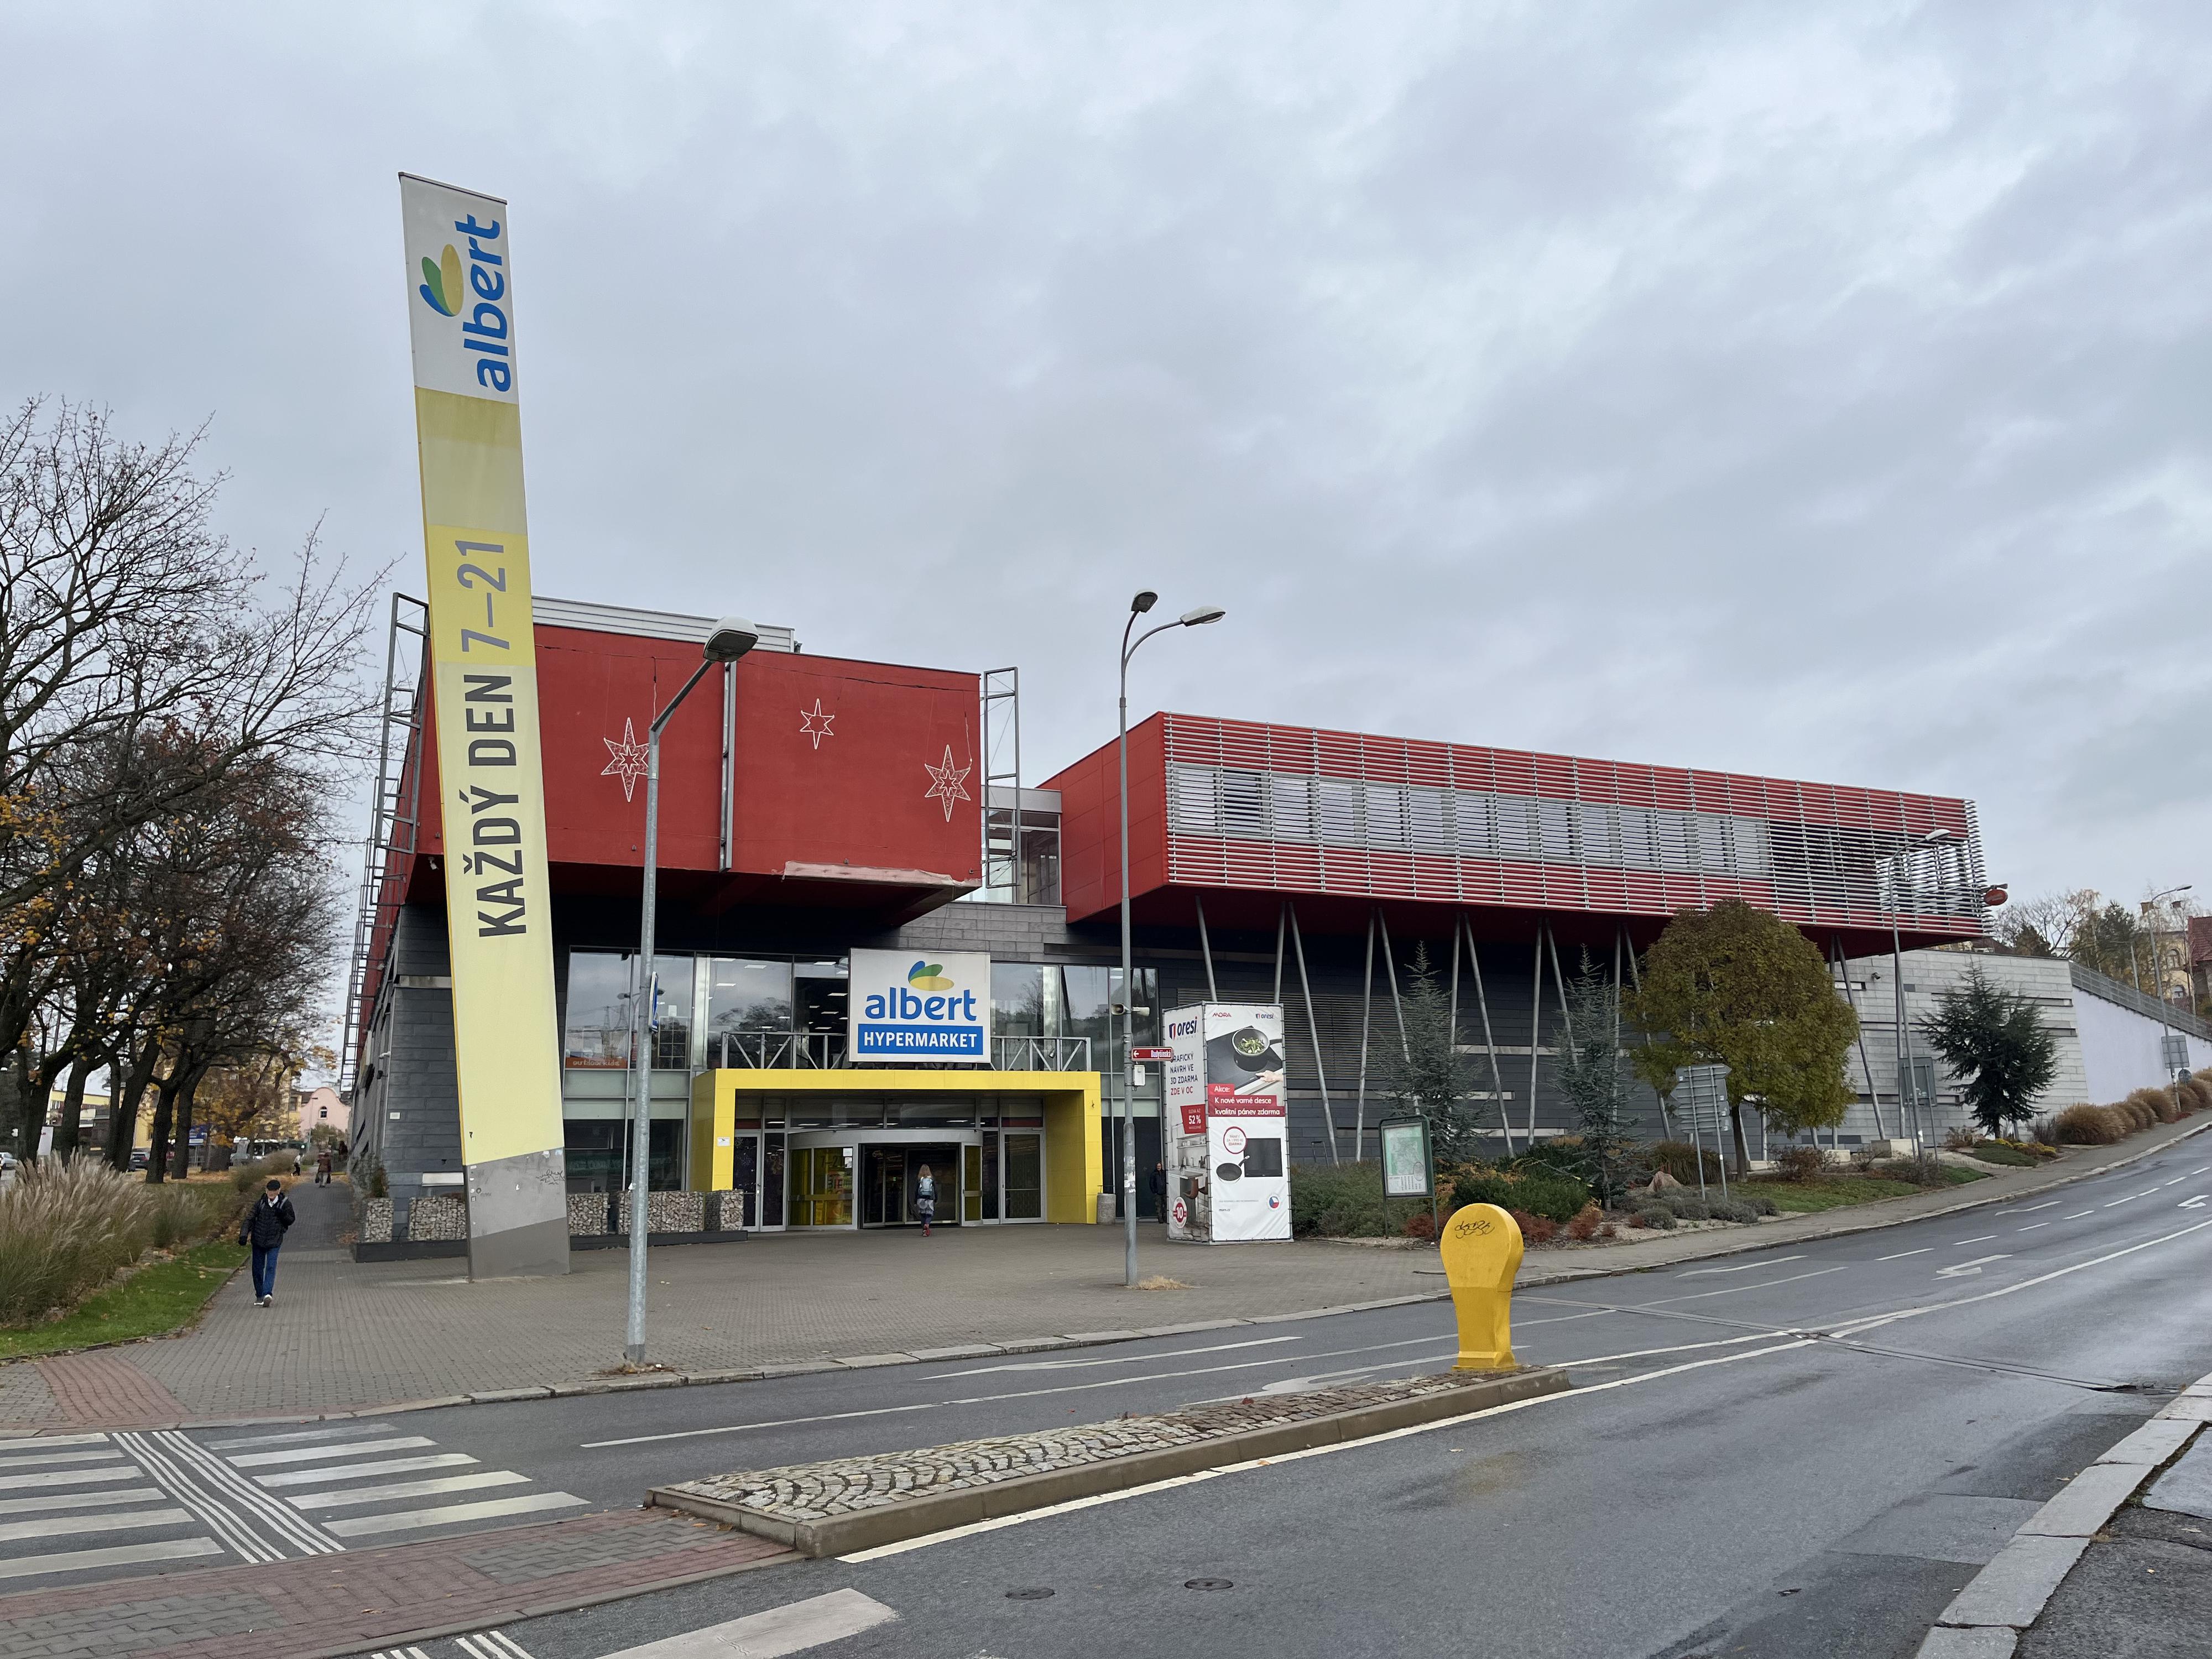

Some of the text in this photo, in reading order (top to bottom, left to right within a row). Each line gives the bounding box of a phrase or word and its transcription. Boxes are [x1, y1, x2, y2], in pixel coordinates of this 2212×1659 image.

[455, 214, 511, 392] albert
[464, 675, 517, 766] DEN
[459, 785, 528, 937] KAŽDÝ
[865, 987, 977, 1021] albert
[1177, 1016, 1198, 1036] oresi
[864, 1031, 977, 1048] HYPERMARKET
[1170, 1063, 1194, 1074] NÁVRH VE
[1178, 1074, 1198, 1084] ZDARMA
[1171, 1087, 1180, 1095] ZDE
[1176, 1206, 1183, 1219] 10
